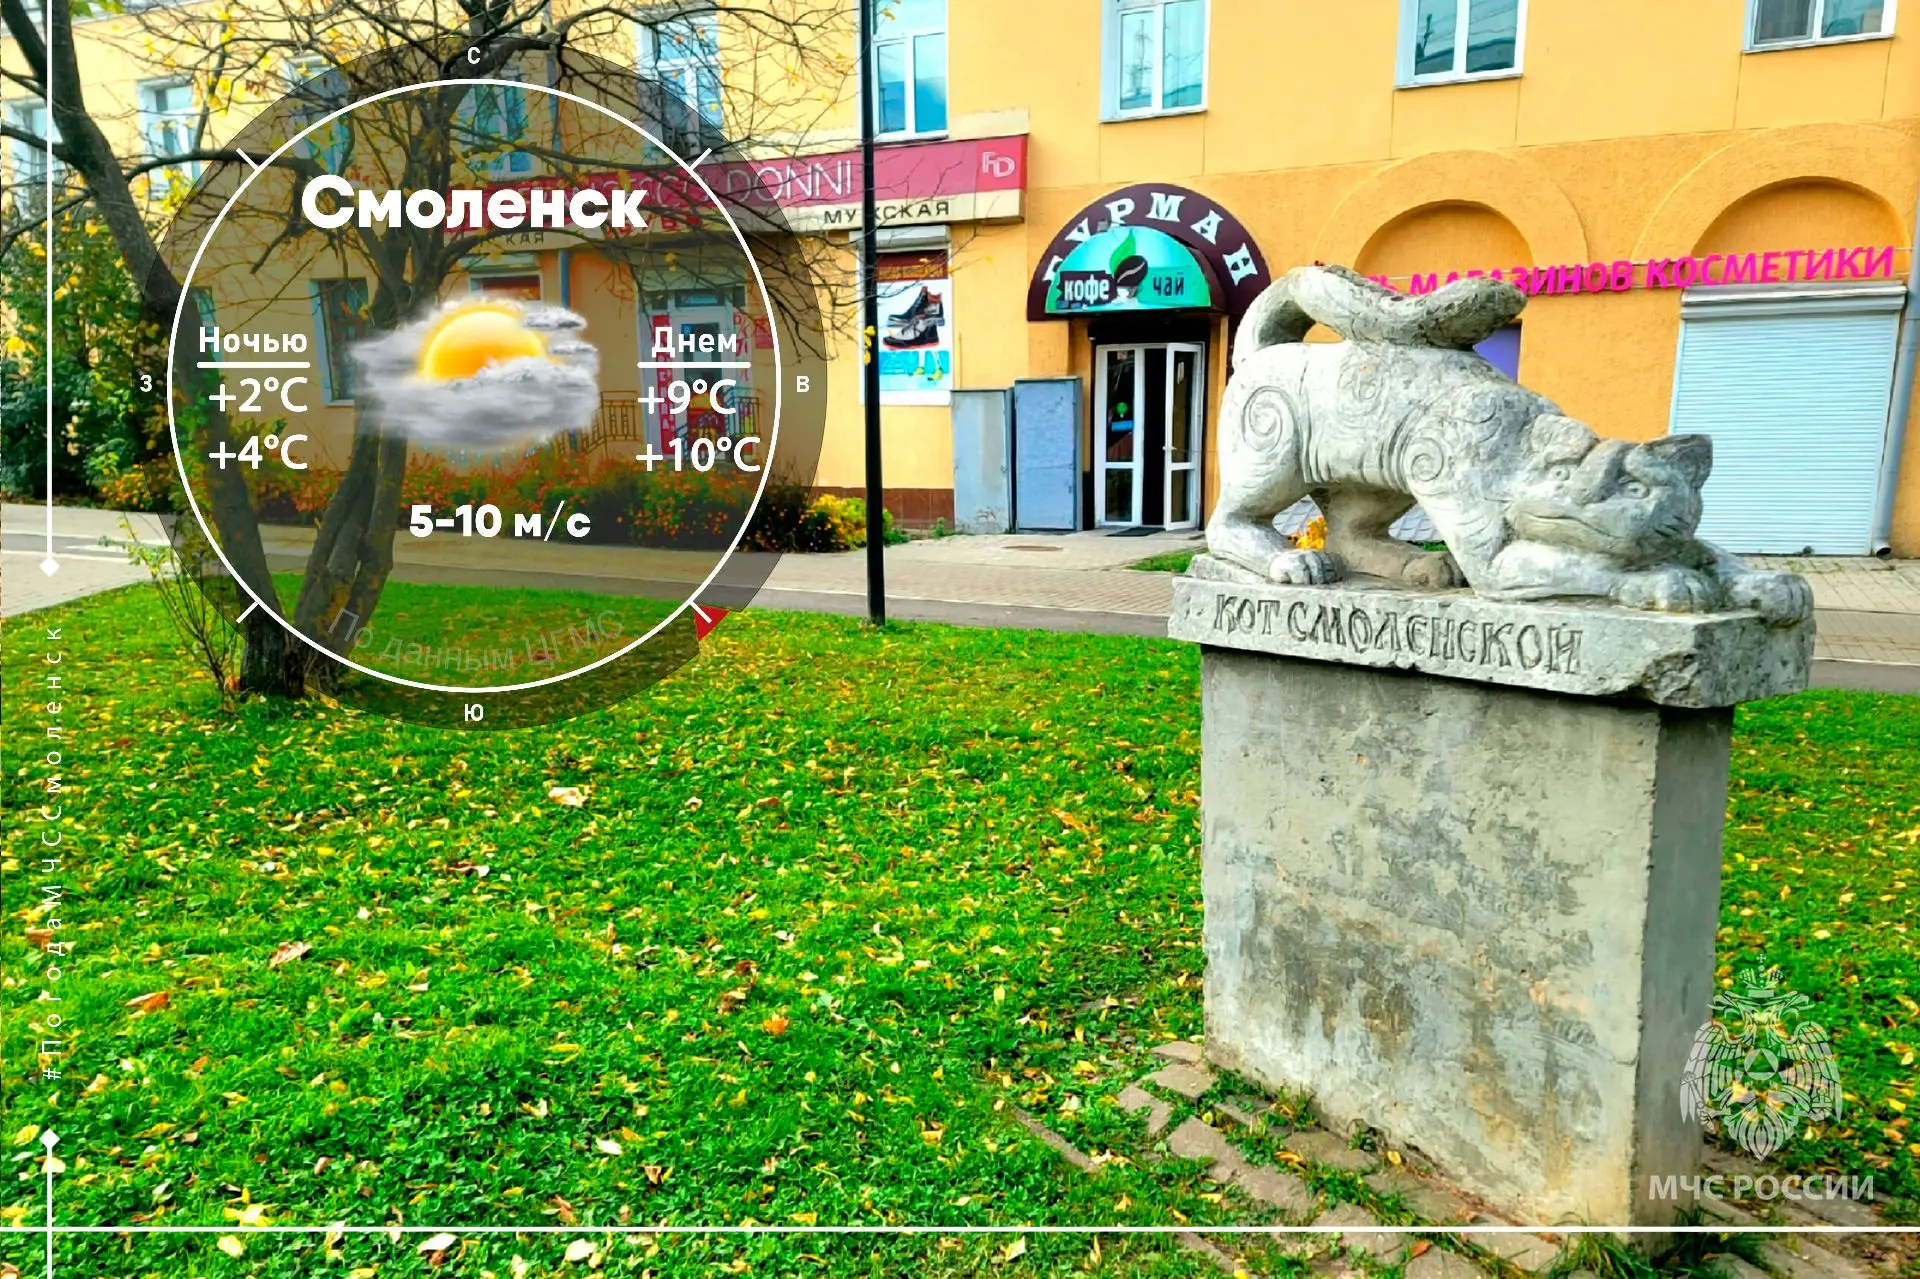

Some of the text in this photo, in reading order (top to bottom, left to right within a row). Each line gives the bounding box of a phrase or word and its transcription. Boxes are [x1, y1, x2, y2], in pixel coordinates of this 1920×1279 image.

[726, 160, 853, 203] DONNI
[1152, 271, 1185, 298] чай
[1645, 245, 1895, 290] КОСМЕТИКИ
[1063, 274, 1110, 305] кофе
[1213, 594, 1281, 635] КОТ
